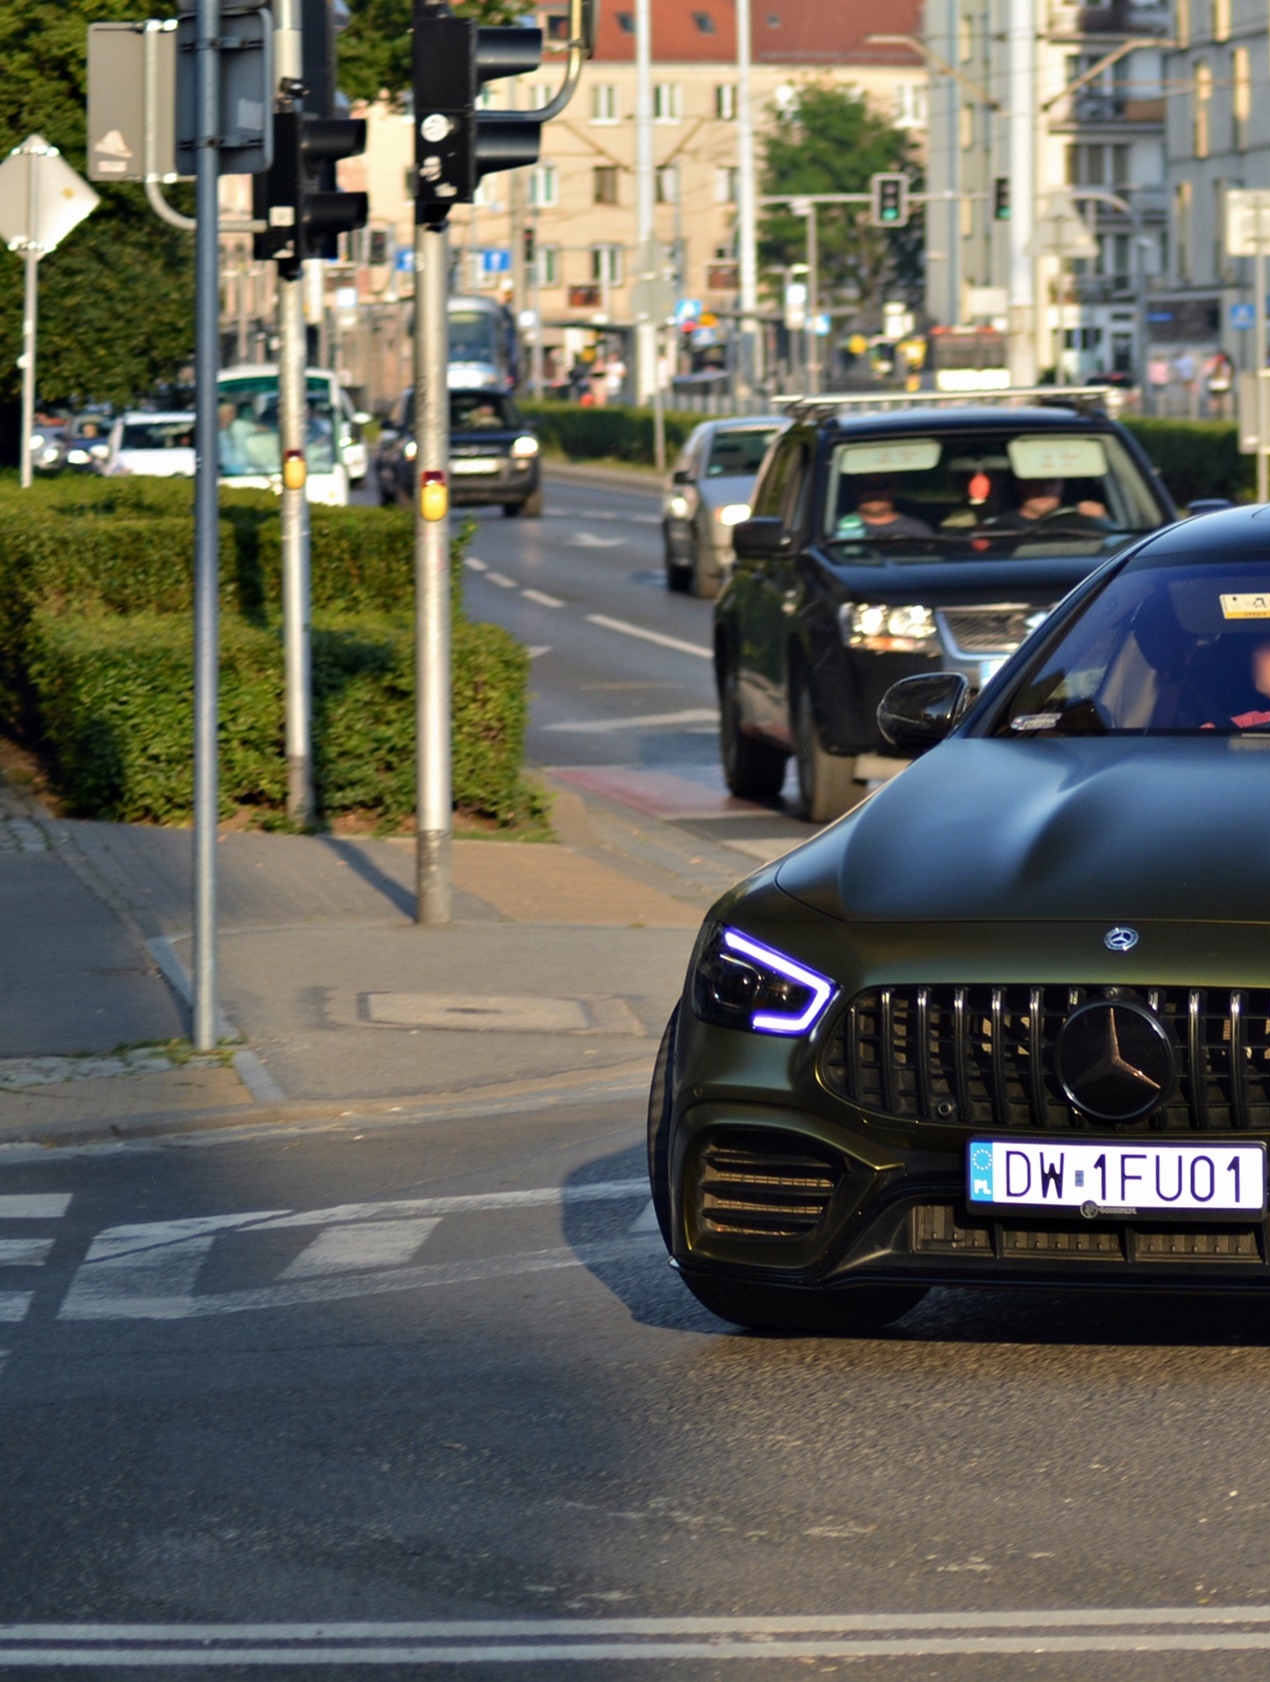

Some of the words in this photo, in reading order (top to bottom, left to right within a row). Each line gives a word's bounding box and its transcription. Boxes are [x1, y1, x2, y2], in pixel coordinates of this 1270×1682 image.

[973, 1179, 992, 1195] PL
[1005, 1150, 1065, 1199] DW
[1093, 1153, 1241, 1203] 1FU01
